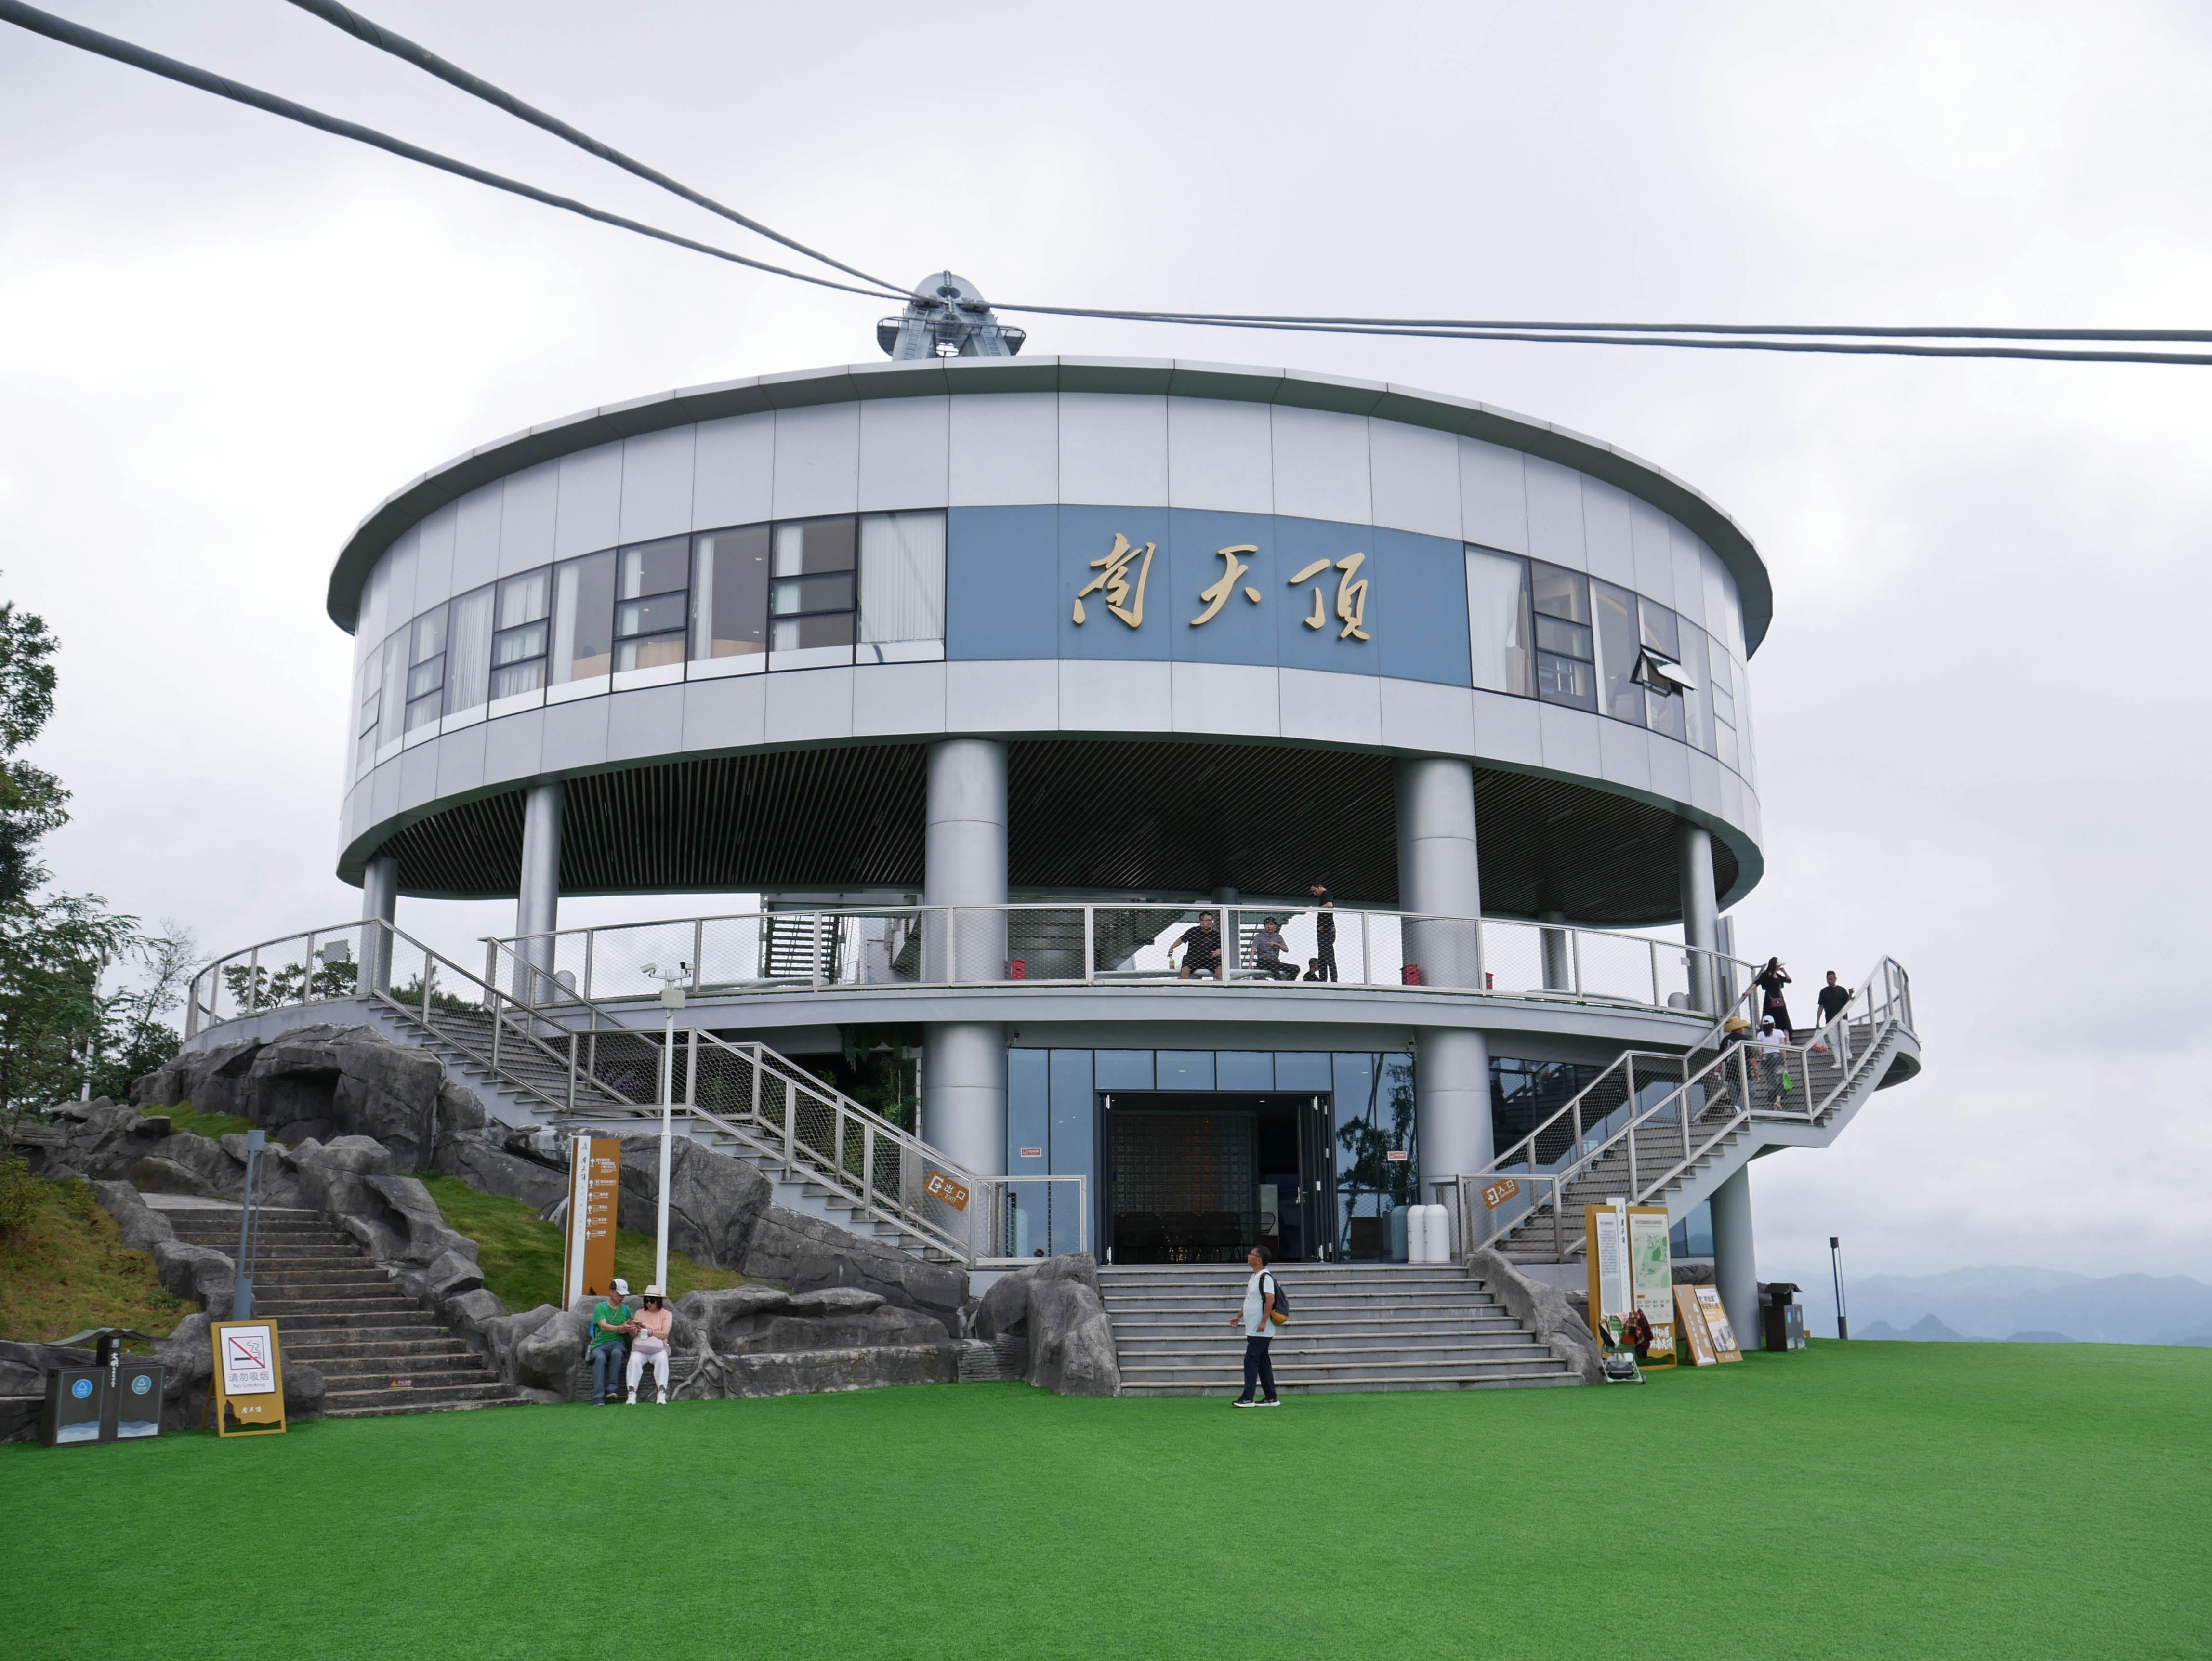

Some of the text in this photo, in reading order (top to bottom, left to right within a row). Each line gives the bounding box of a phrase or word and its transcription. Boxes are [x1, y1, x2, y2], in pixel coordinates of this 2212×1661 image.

[1072, 533, 1369, 640] 南天顶
[944, 1183, 966, 1200] 出口
[1498, 1180, 1514, 1194] 入口
[944, 1194, 958, 1203] EXIT
[229, 1371, 269, 1382] 请勿吸烟
